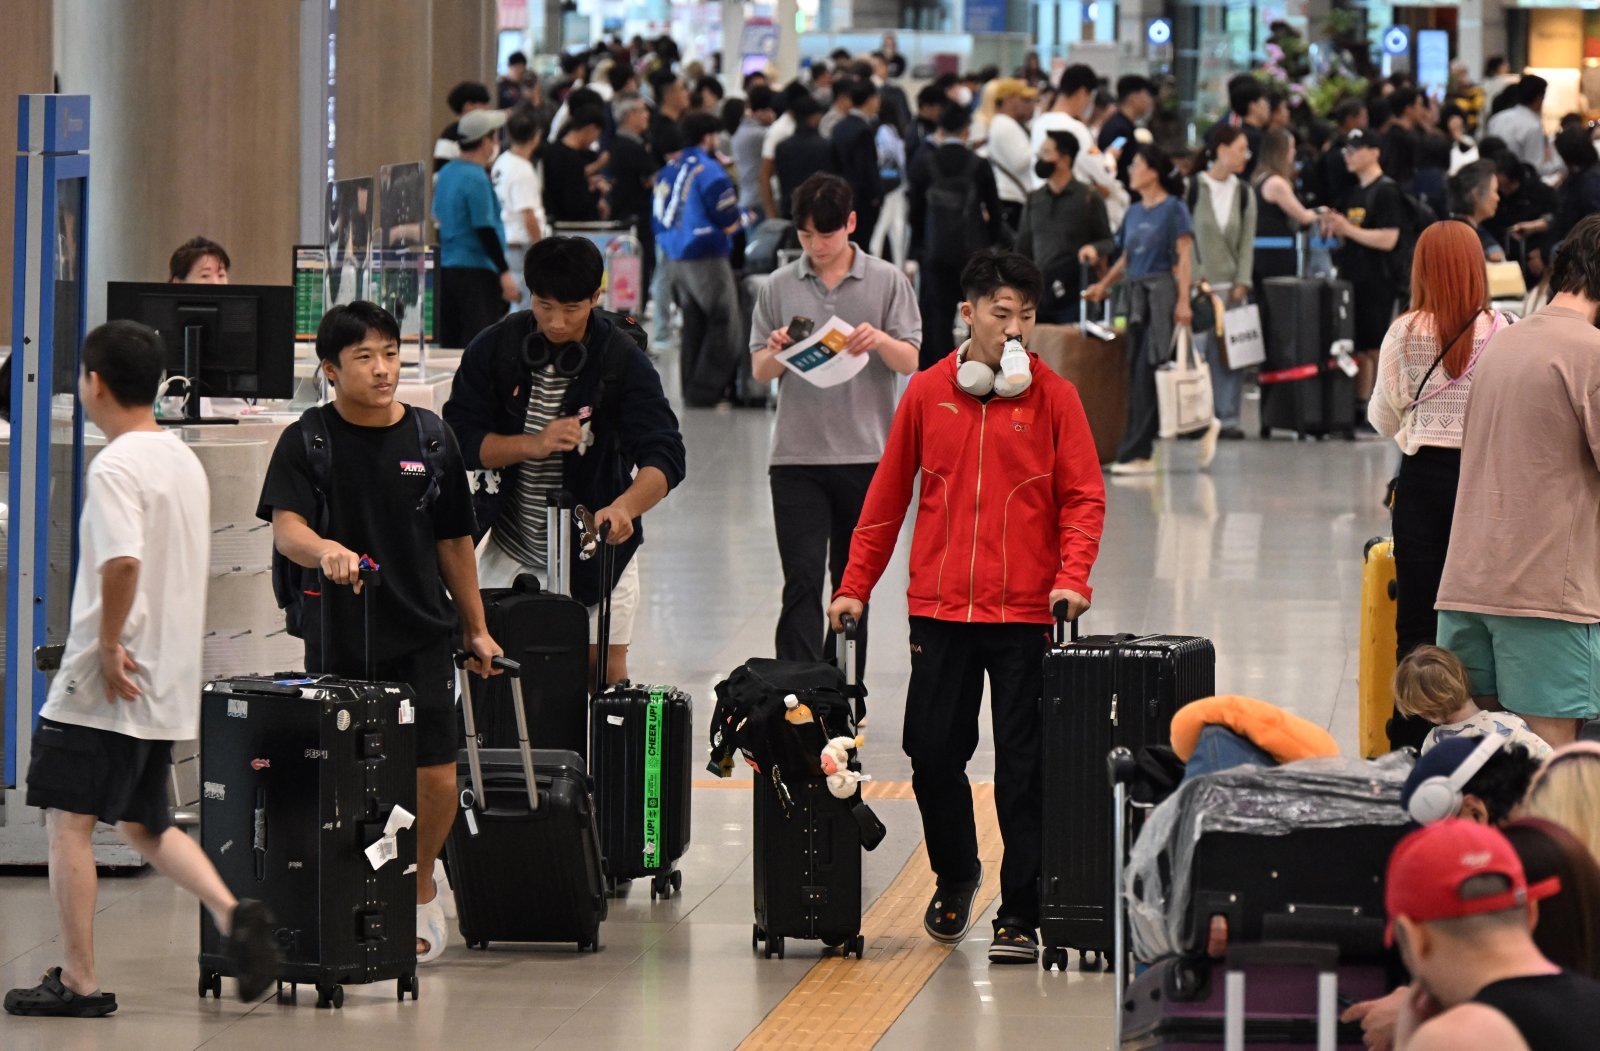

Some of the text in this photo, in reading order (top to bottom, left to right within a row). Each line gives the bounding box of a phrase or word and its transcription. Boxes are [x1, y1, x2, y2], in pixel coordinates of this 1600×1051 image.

[404, 463, 426, 472] ANTA
[648, 705, 657, 756] CHEER UP!
[647, 819, 655, 869] CHR UP!
